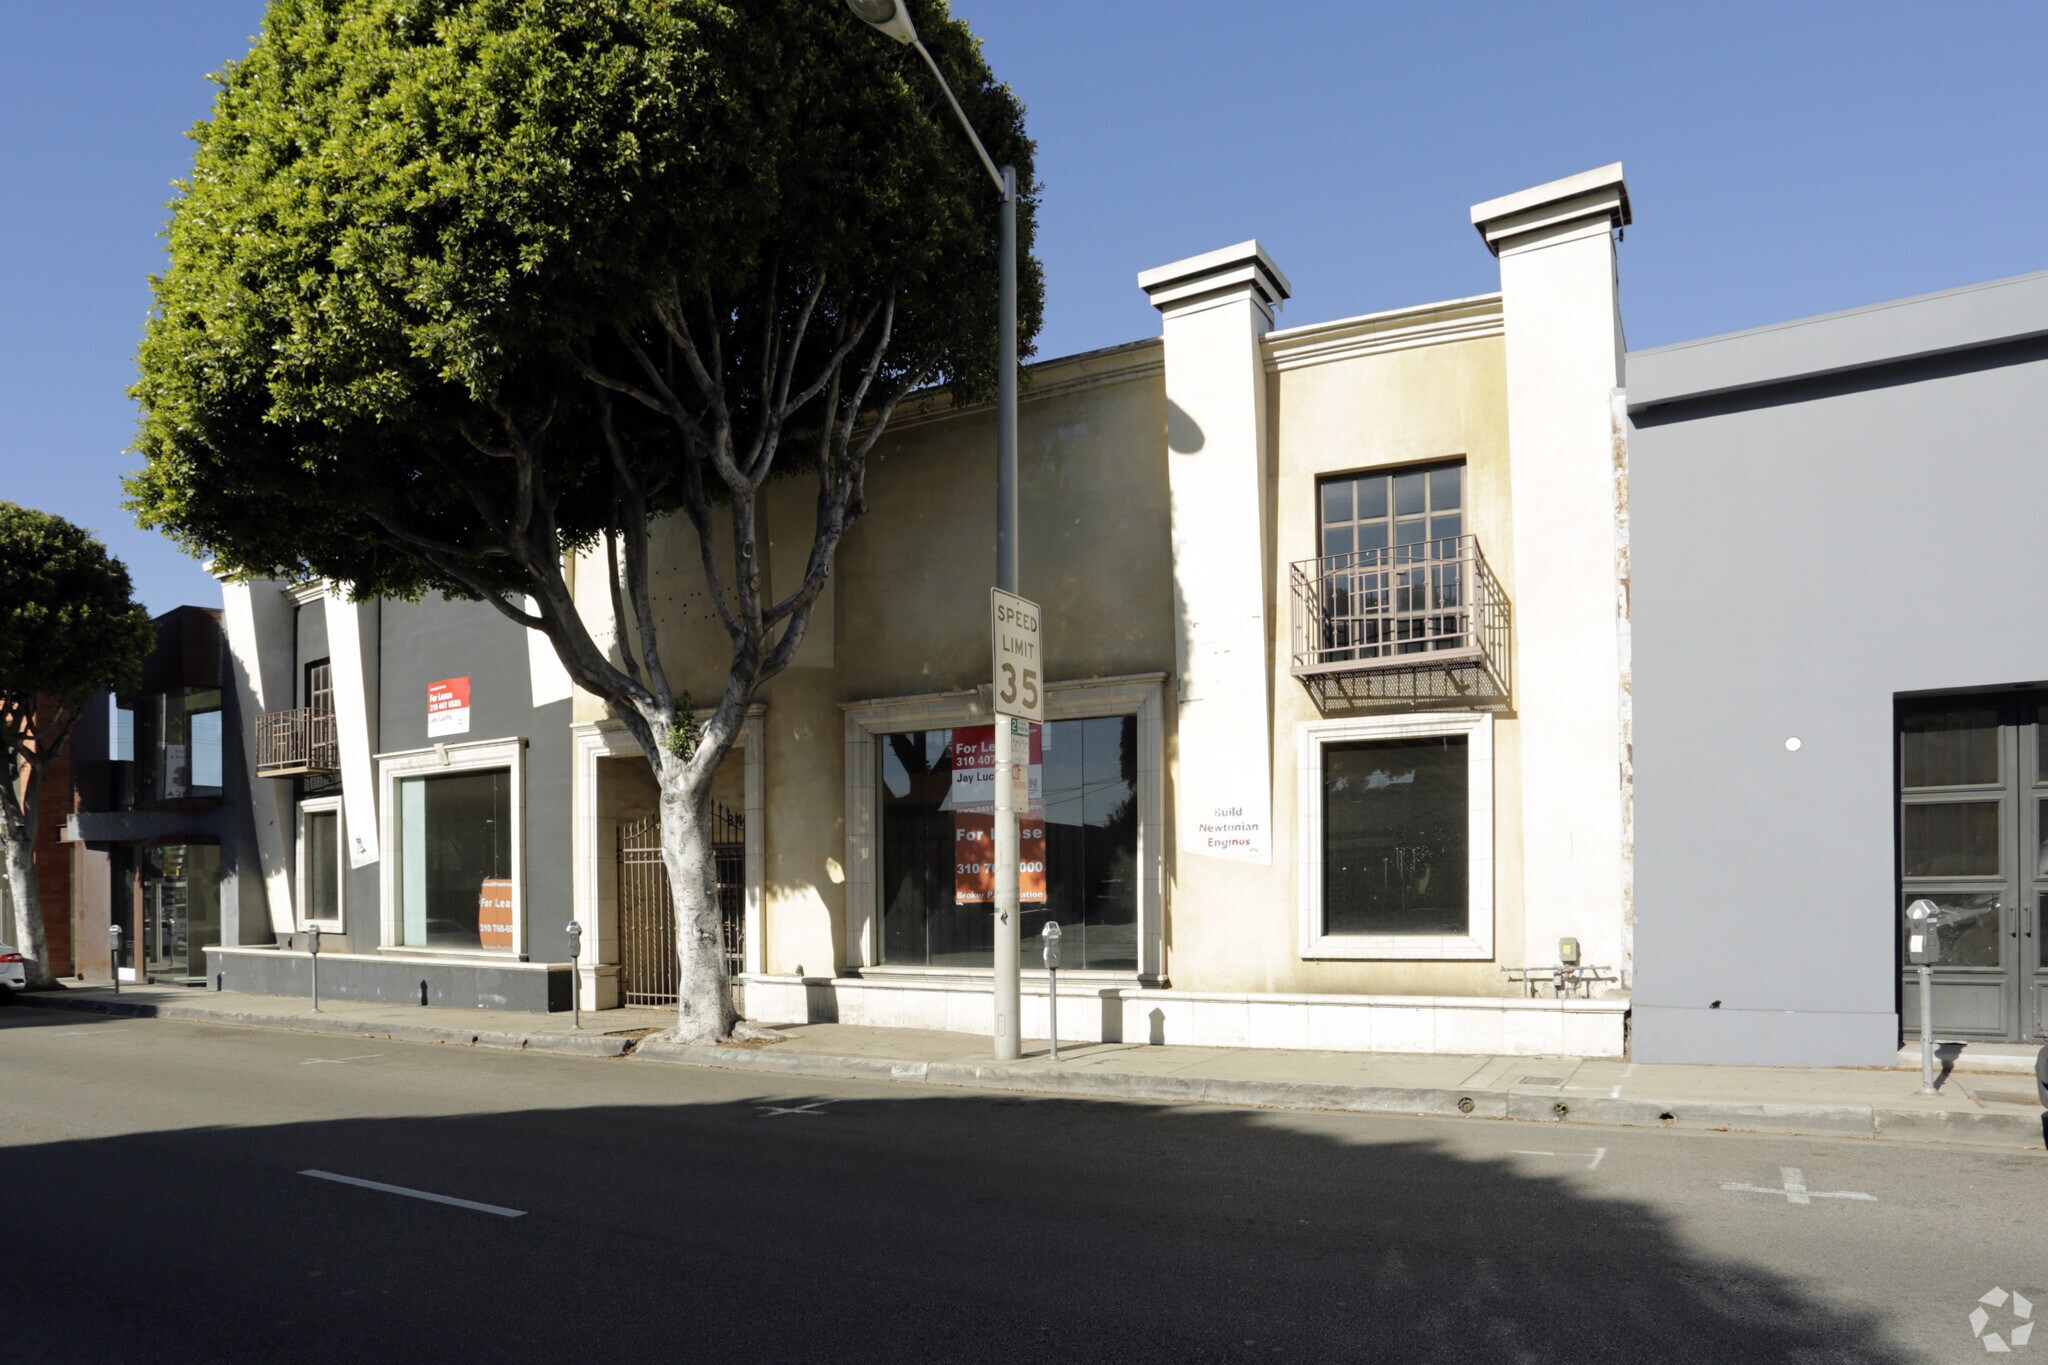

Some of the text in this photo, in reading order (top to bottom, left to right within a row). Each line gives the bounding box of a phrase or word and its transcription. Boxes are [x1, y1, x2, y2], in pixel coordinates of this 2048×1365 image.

[998, 604, 1038, 632] SPEED
[1003, 634, 1034, 658] LIMIT
[1000, 663, 1038, 709] 35
[1011, 719, 1017, 731] 2
[956, 743, 977, 754] For
[957, 757, 975, 767] 310
[957, 772, 995, 784] Jay Luc
[1199, 822, 1259, 832] Newtonian
[957, 829, 984, 841] For
[1207, 837, 1250, 849] Engines
[957, 863, 980, 874] 310
[957, 891, 985, 899] Broker
[480, 898, 512, 908] For Lea
[480, 924, 492, 932] 310
